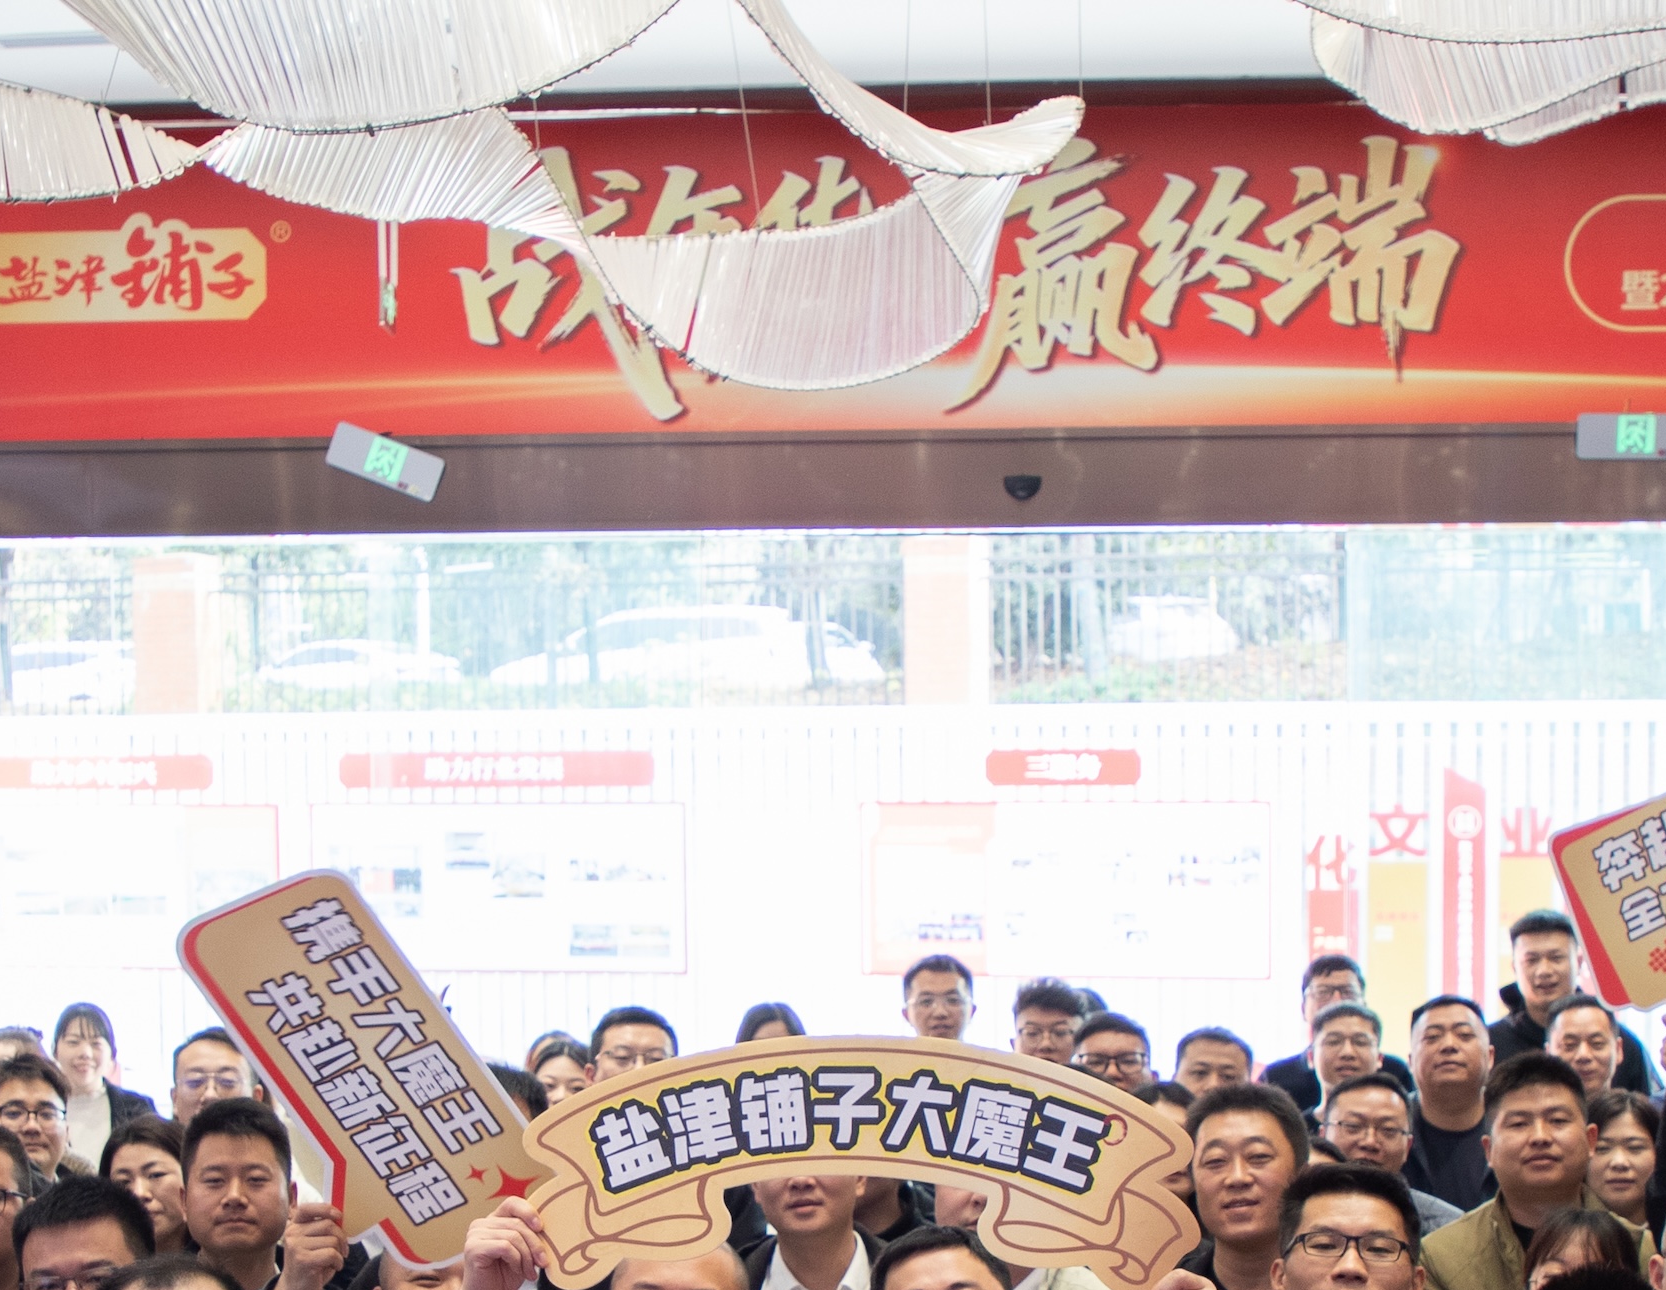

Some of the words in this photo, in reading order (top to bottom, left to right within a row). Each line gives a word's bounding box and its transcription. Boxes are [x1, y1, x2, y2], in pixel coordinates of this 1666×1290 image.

[245, 972, 468, 1227] 共赴新征程
[280, 897, 504, 1155] 携手大魔王
[590, 1066, 1110, 1193] 盐津铺子大魔王
